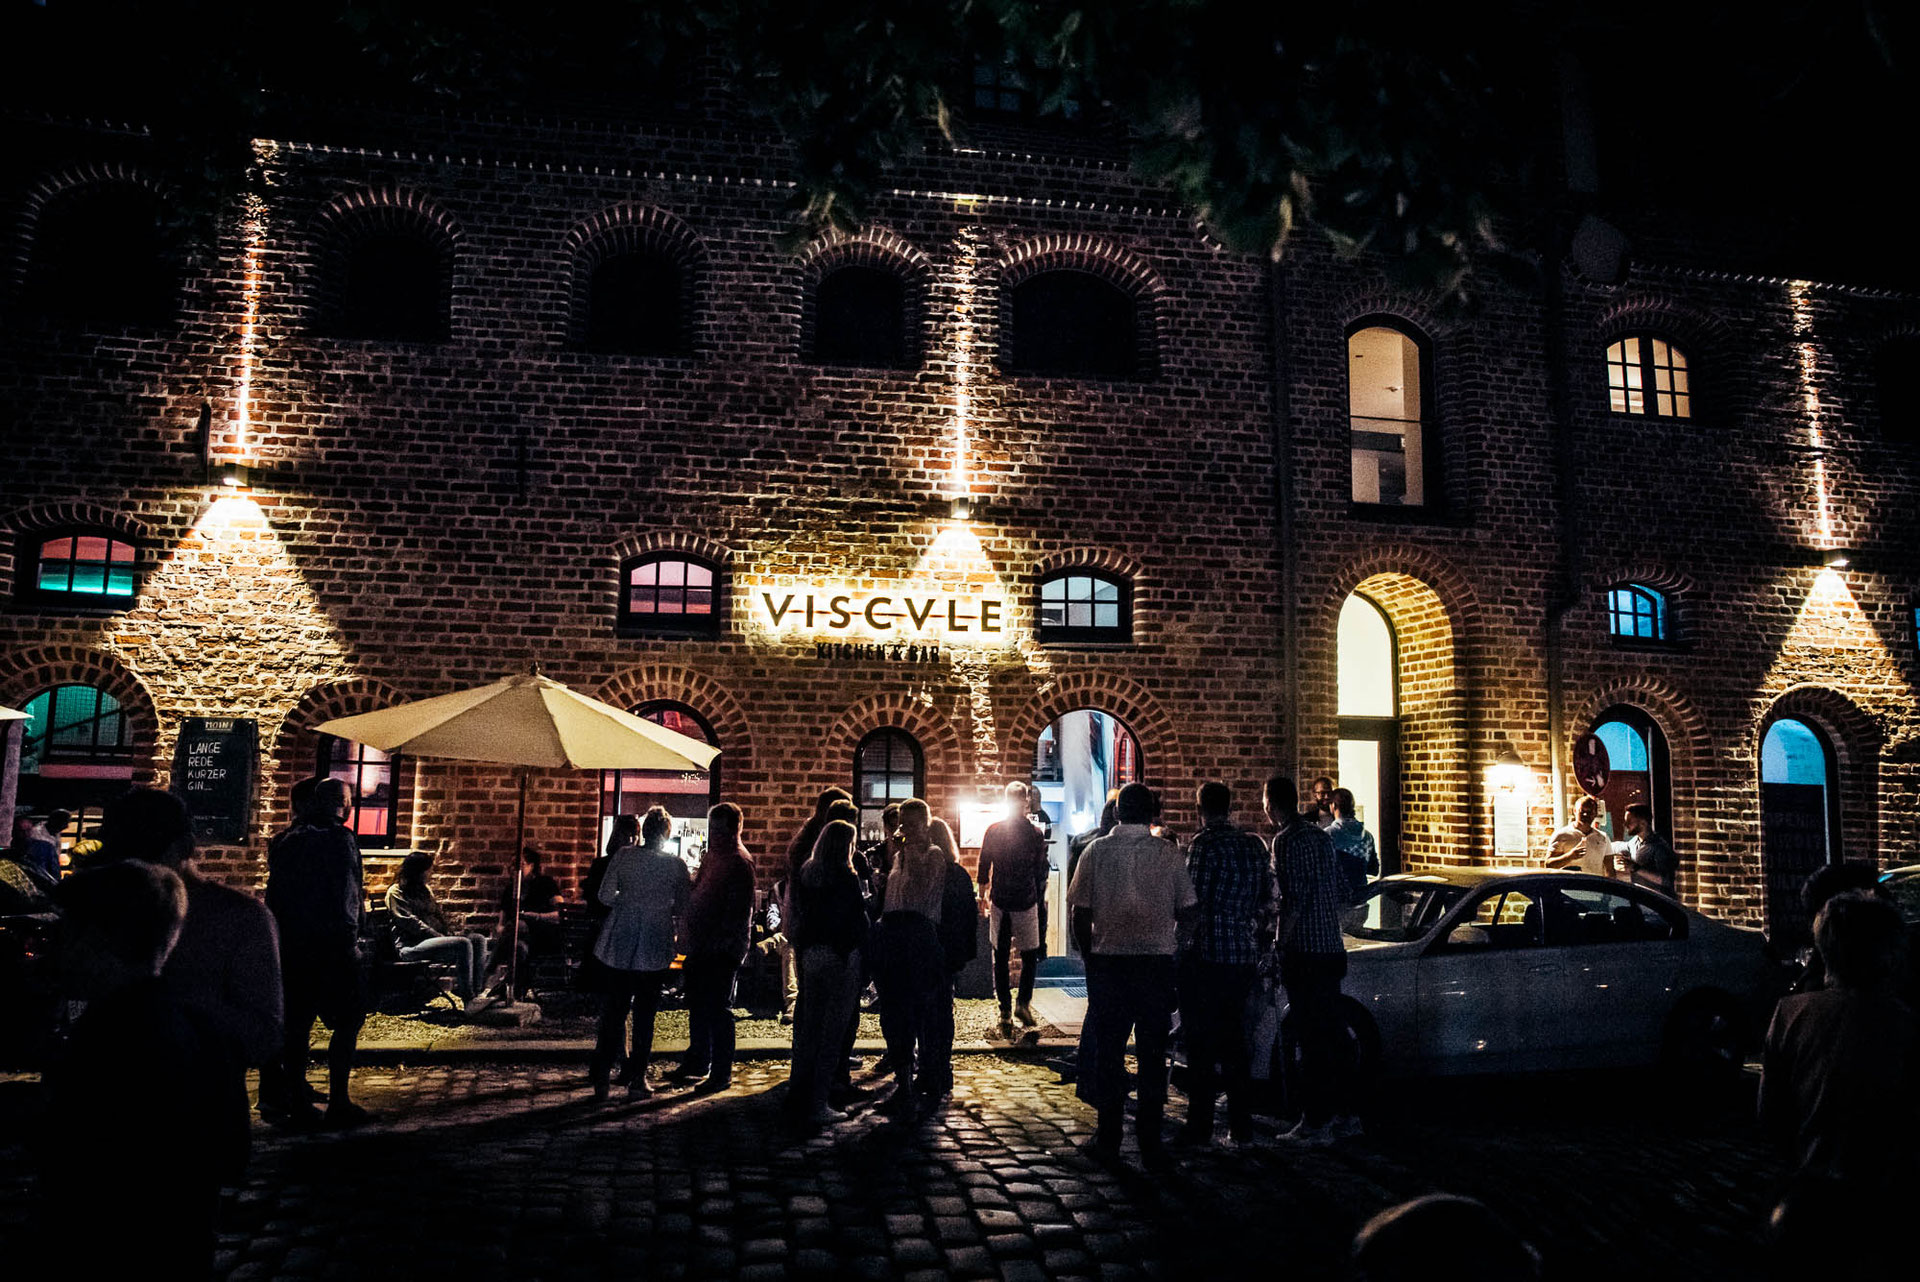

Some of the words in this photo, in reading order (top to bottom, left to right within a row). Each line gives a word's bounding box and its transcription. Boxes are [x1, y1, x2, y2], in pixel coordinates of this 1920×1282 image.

[817, 643, 886, 661] KITCHEN
[893, 644, 903, 661] &
[910, 645, 940, 662] BAR
[189, 741, 221, 754] LANGE
[187, 756, 214, 767] REDE
[187, 769, 226, 780] KURZER
